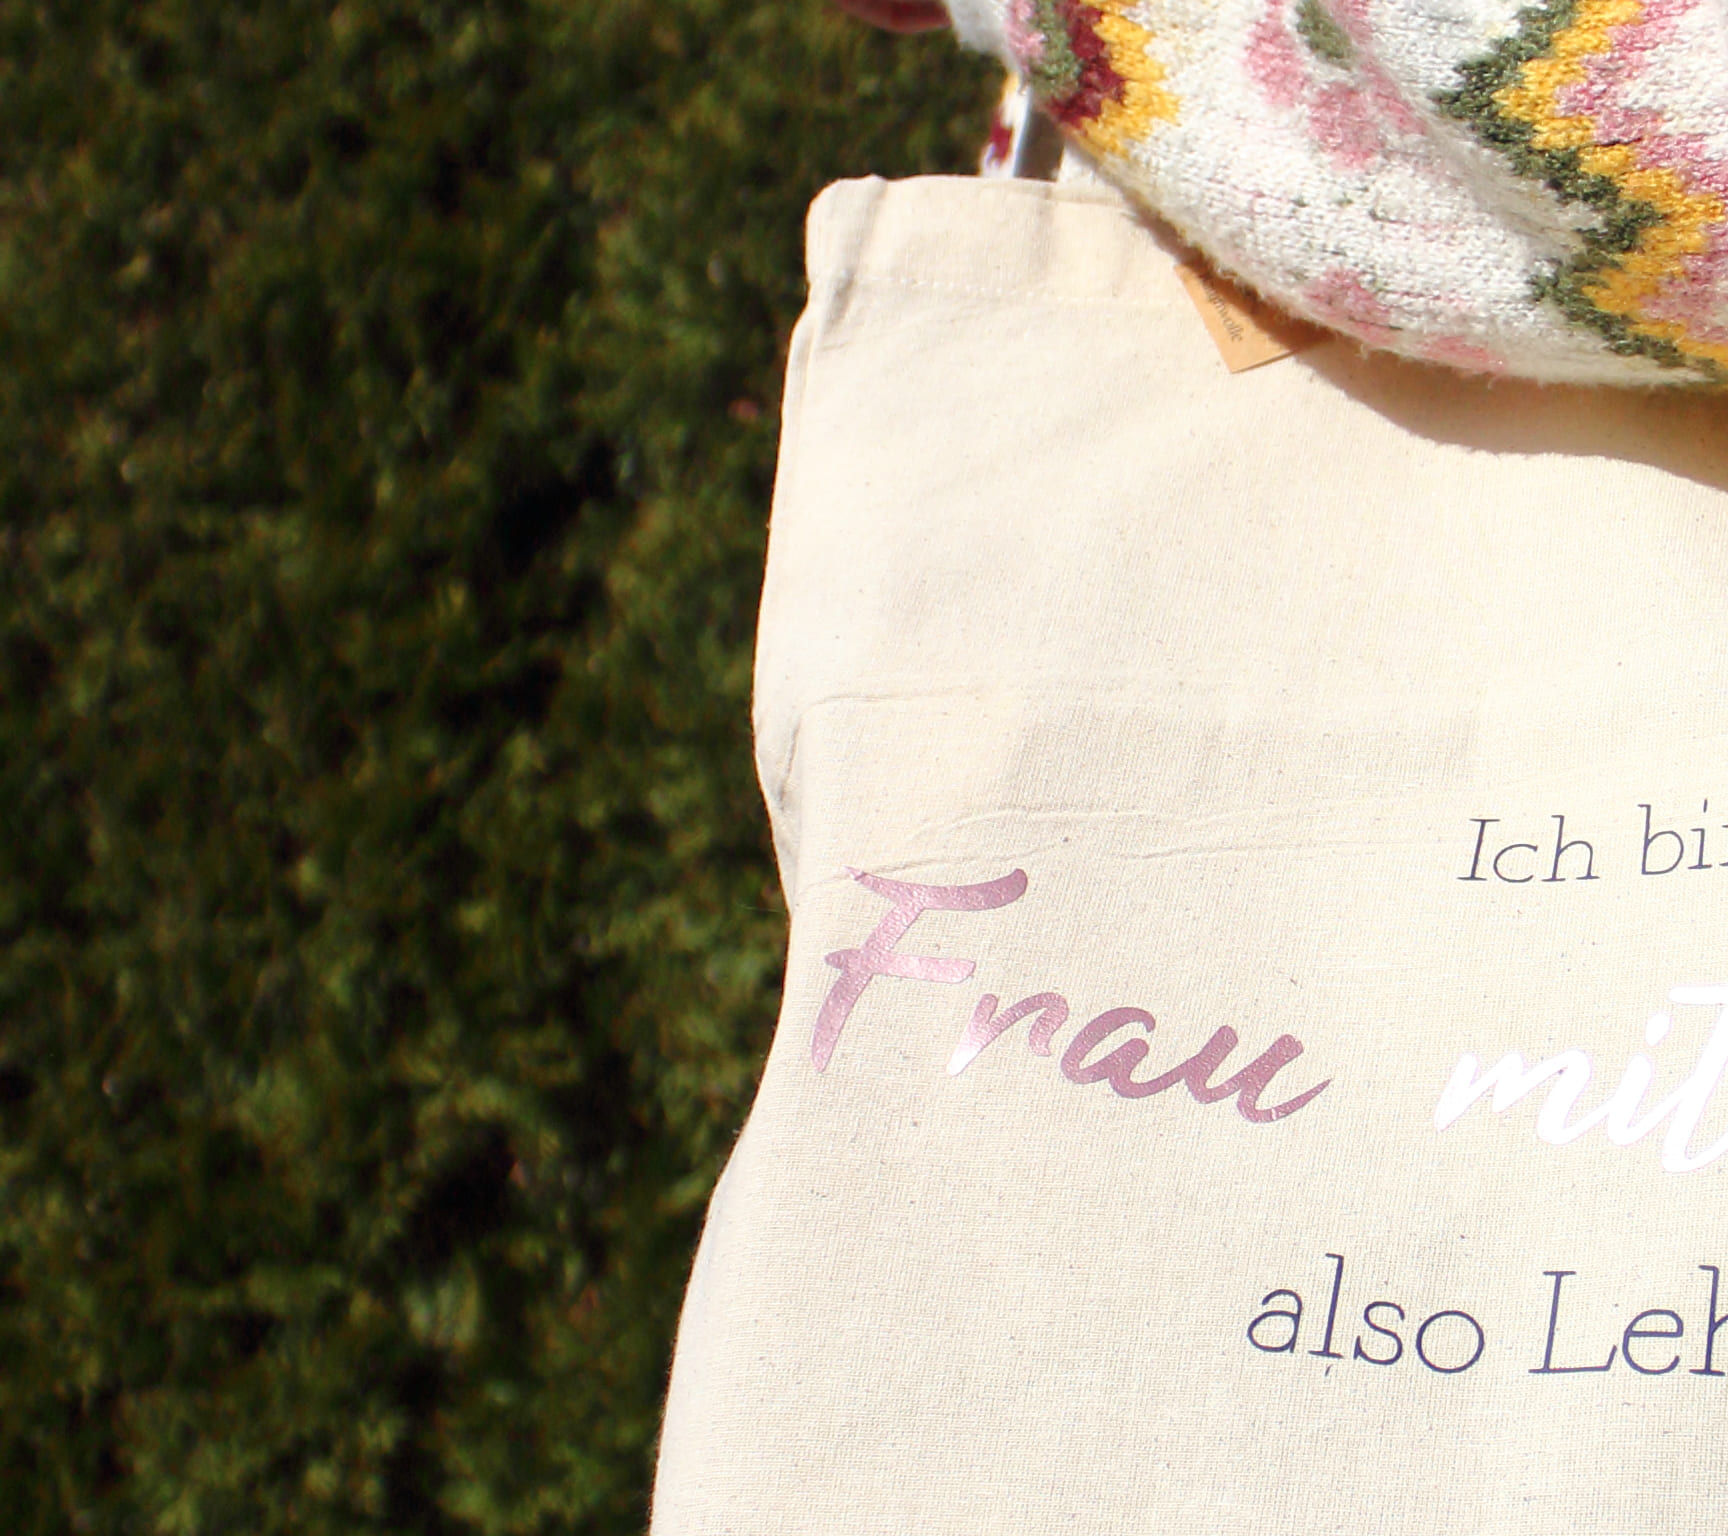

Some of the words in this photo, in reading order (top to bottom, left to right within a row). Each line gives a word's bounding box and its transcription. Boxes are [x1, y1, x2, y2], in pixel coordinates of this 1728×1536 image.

[1456, 815, 1600, 884] Ich
[810, 866, 1333, 1124] Frau
[1246, 1252, 1486, 1375] also
